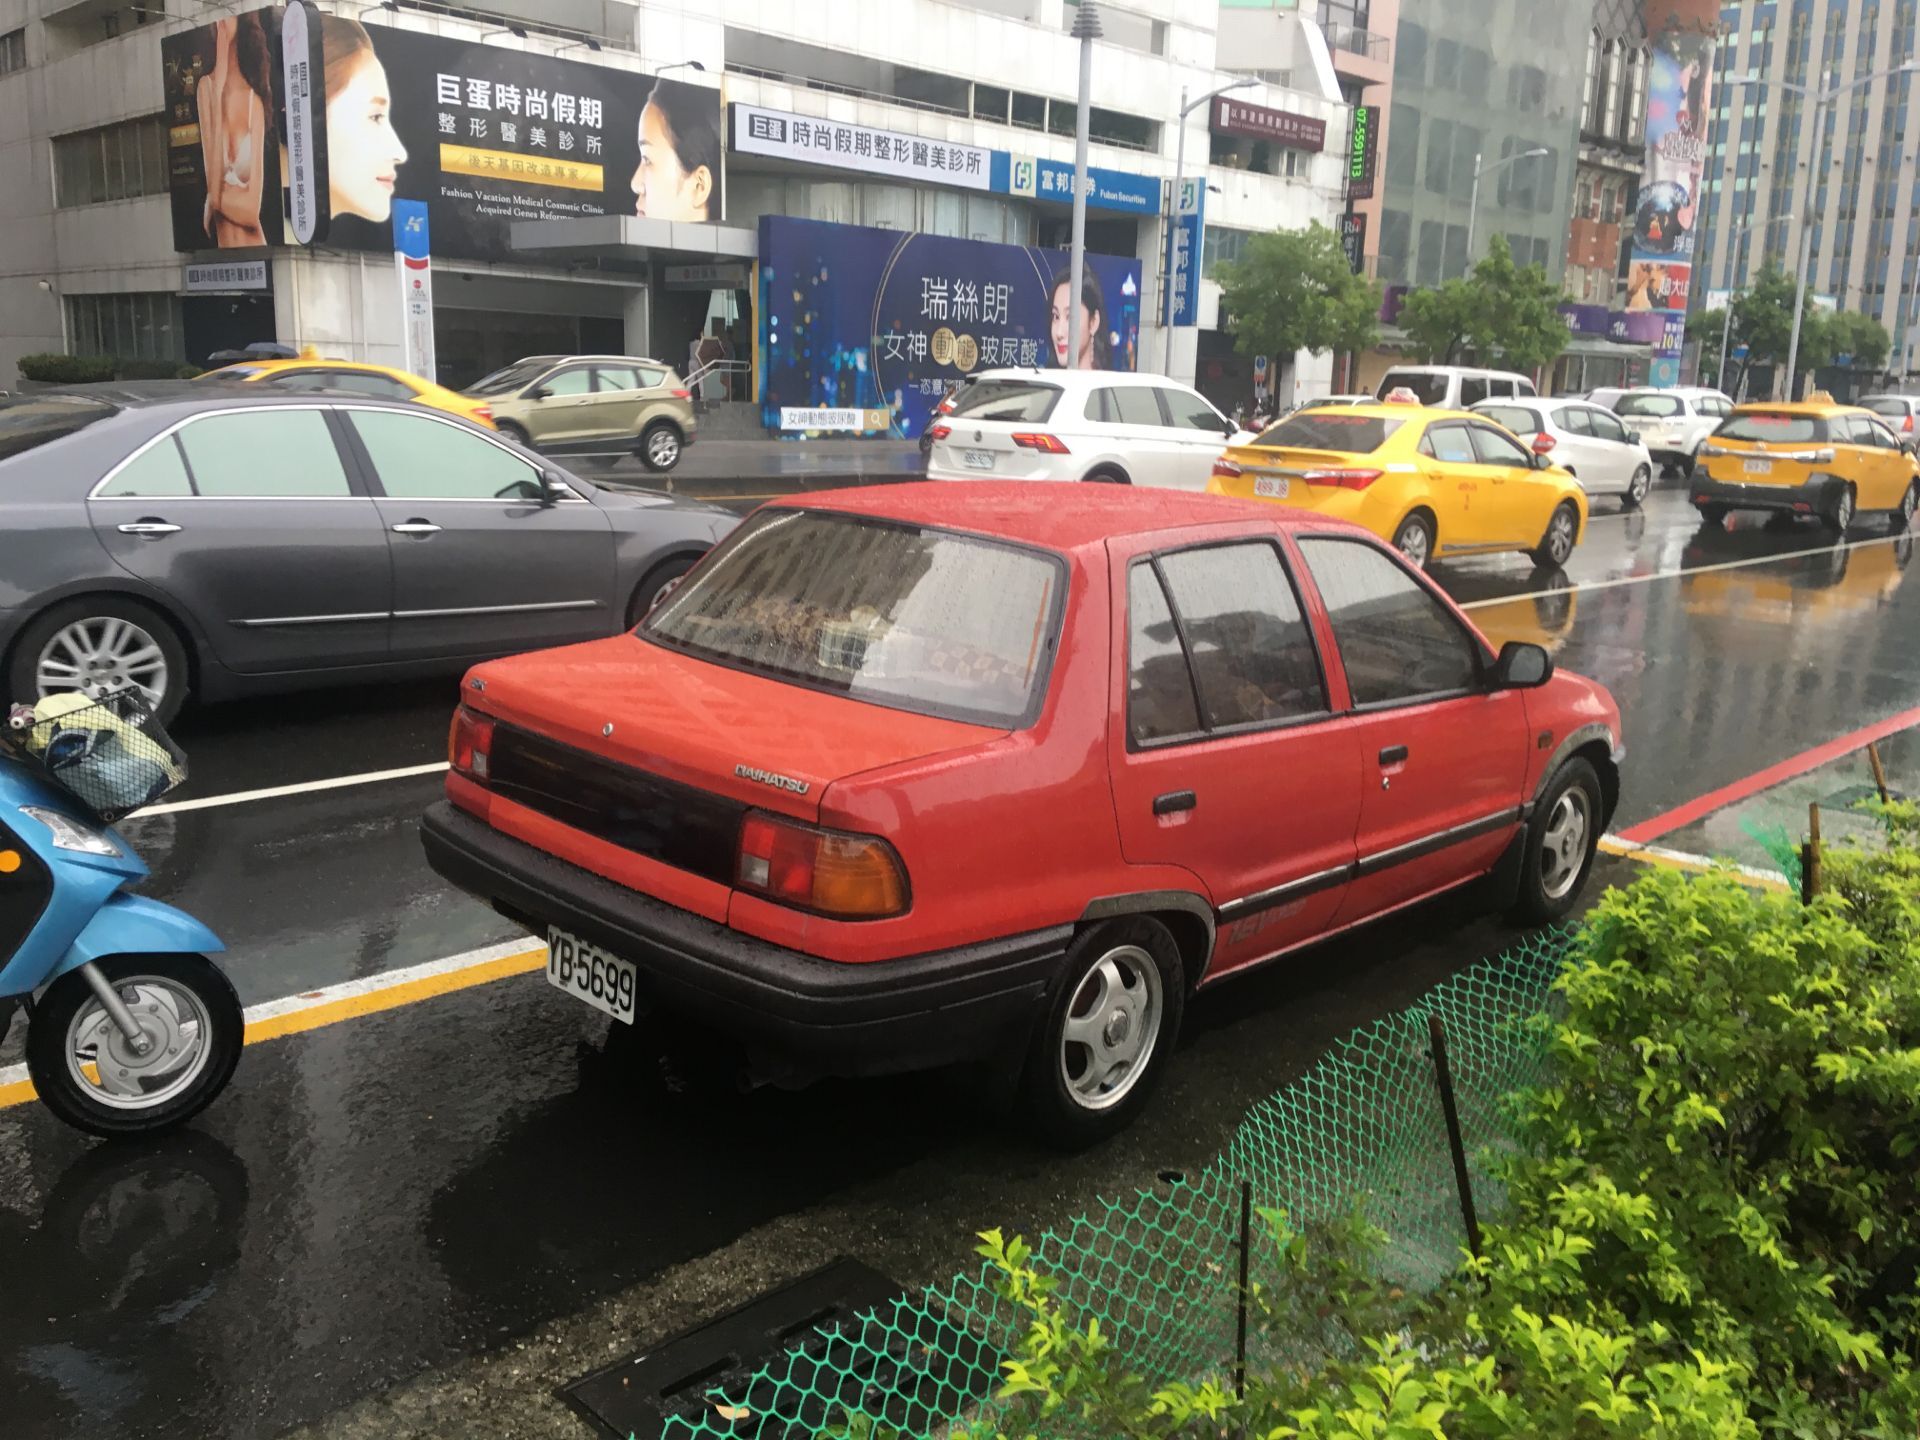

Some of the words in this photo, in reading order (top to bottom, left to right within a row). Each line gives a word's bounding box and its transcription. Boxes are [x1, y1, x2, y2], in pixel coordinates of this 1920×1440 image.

[436, 73, 603, 129] 巨蛋時尚假期
[438, 112, 602, 155] 整形醫美診所
[1352, 108, 1367, 178] 07-5591113
[440, 187, 473, 199] Fashion
[475, 190, 511, 204] Vacation
[512, 195, 544, 208] Medical
[545, 199, 580, 213] Cosmetic
[581, 203, 605, 215] Clinic
[475, 204, 512, 218] Acquired
[513, 207, 538, 219] Genes
[1100, 189, 1118, 200] Fubon
[1119, 191, 1146, 205] Securities
[920, 276, 1010, 326] 瑞絲朗
[883, 328, 1039, 371] 女神動態玻尿酸
[735, 763, 809, 794] DAIHATSU
[549, 932, 633, 1013] YB-5699
